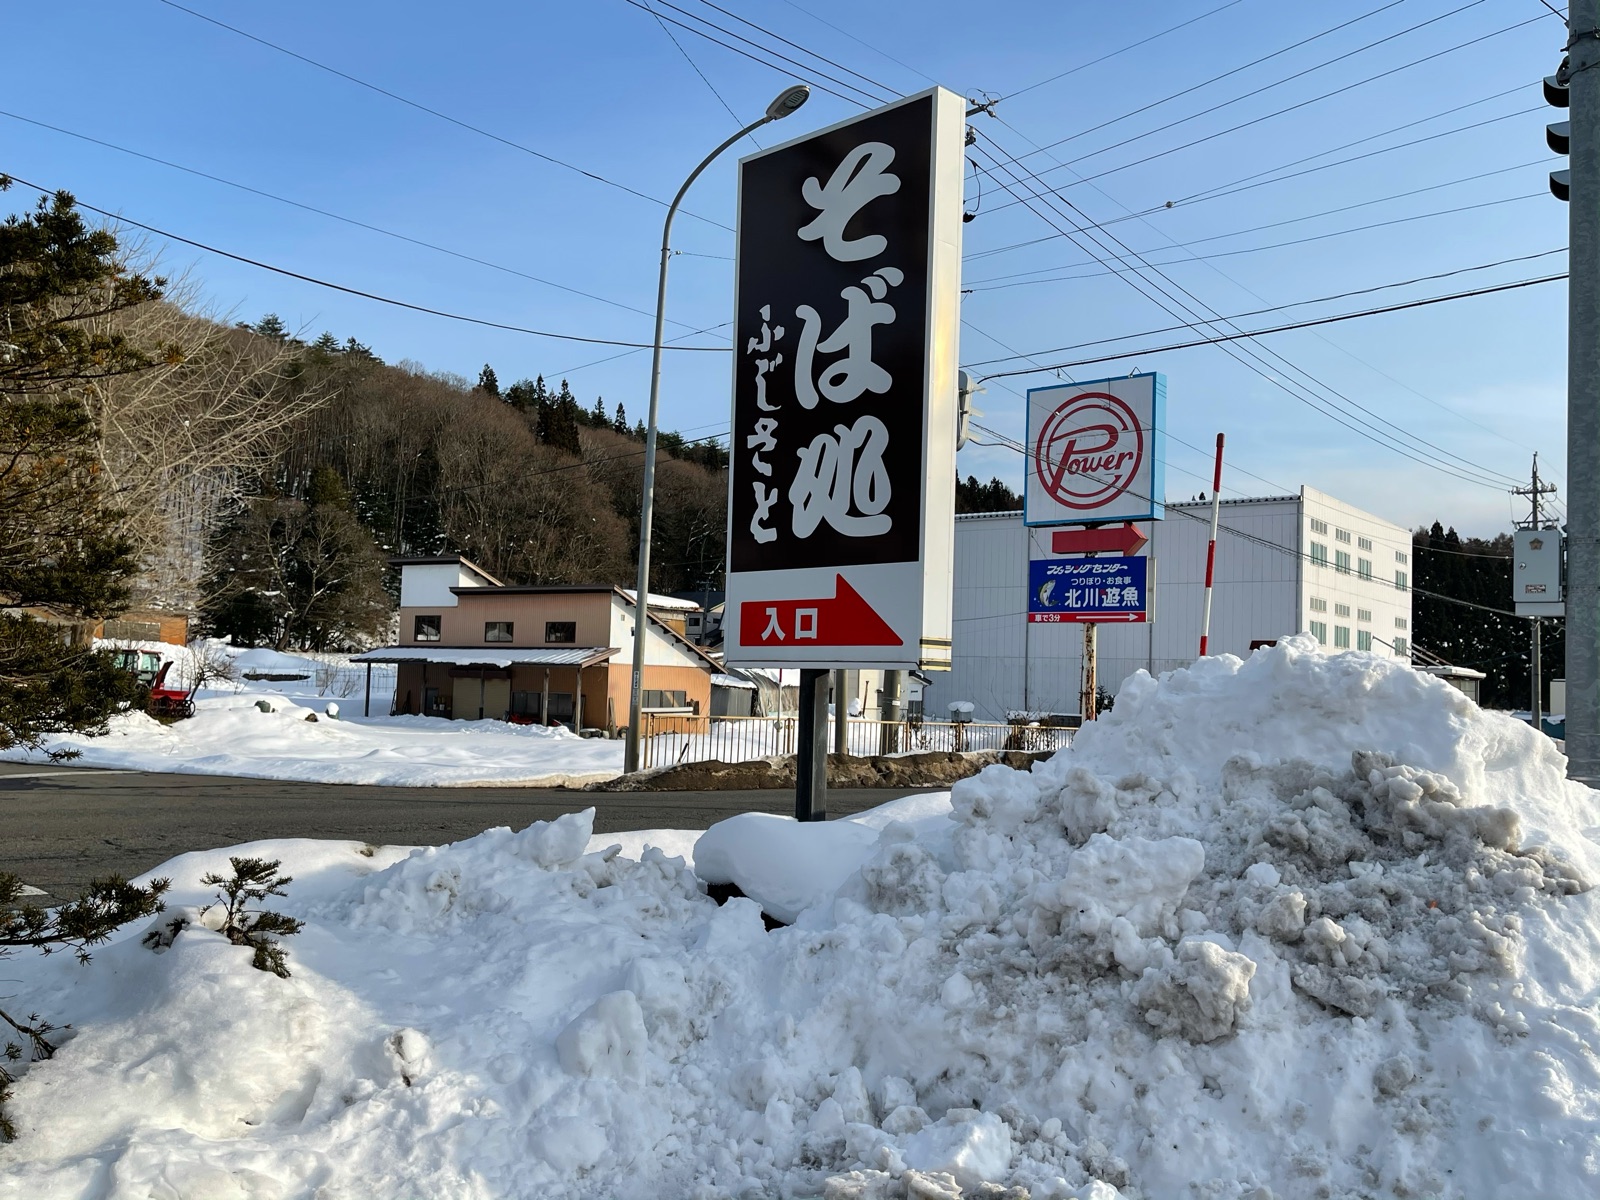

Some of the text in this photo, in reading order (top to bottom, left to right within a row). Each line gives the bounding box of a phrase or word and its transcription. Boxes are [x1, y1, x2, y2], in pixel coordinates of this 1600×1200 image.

[791, 142, 904, 538] そば処
[747, 305, 784, 544] ふじさと
[1050, 424, 1133, 494] Power
[1046, 564, 1128, 575] フィッシングセンター
[1071, 577, 1131, 585] つりぼり・お食事
[760, 608, 818, 640] 入口
[1035, 614, 1060, 622] 車で3分
